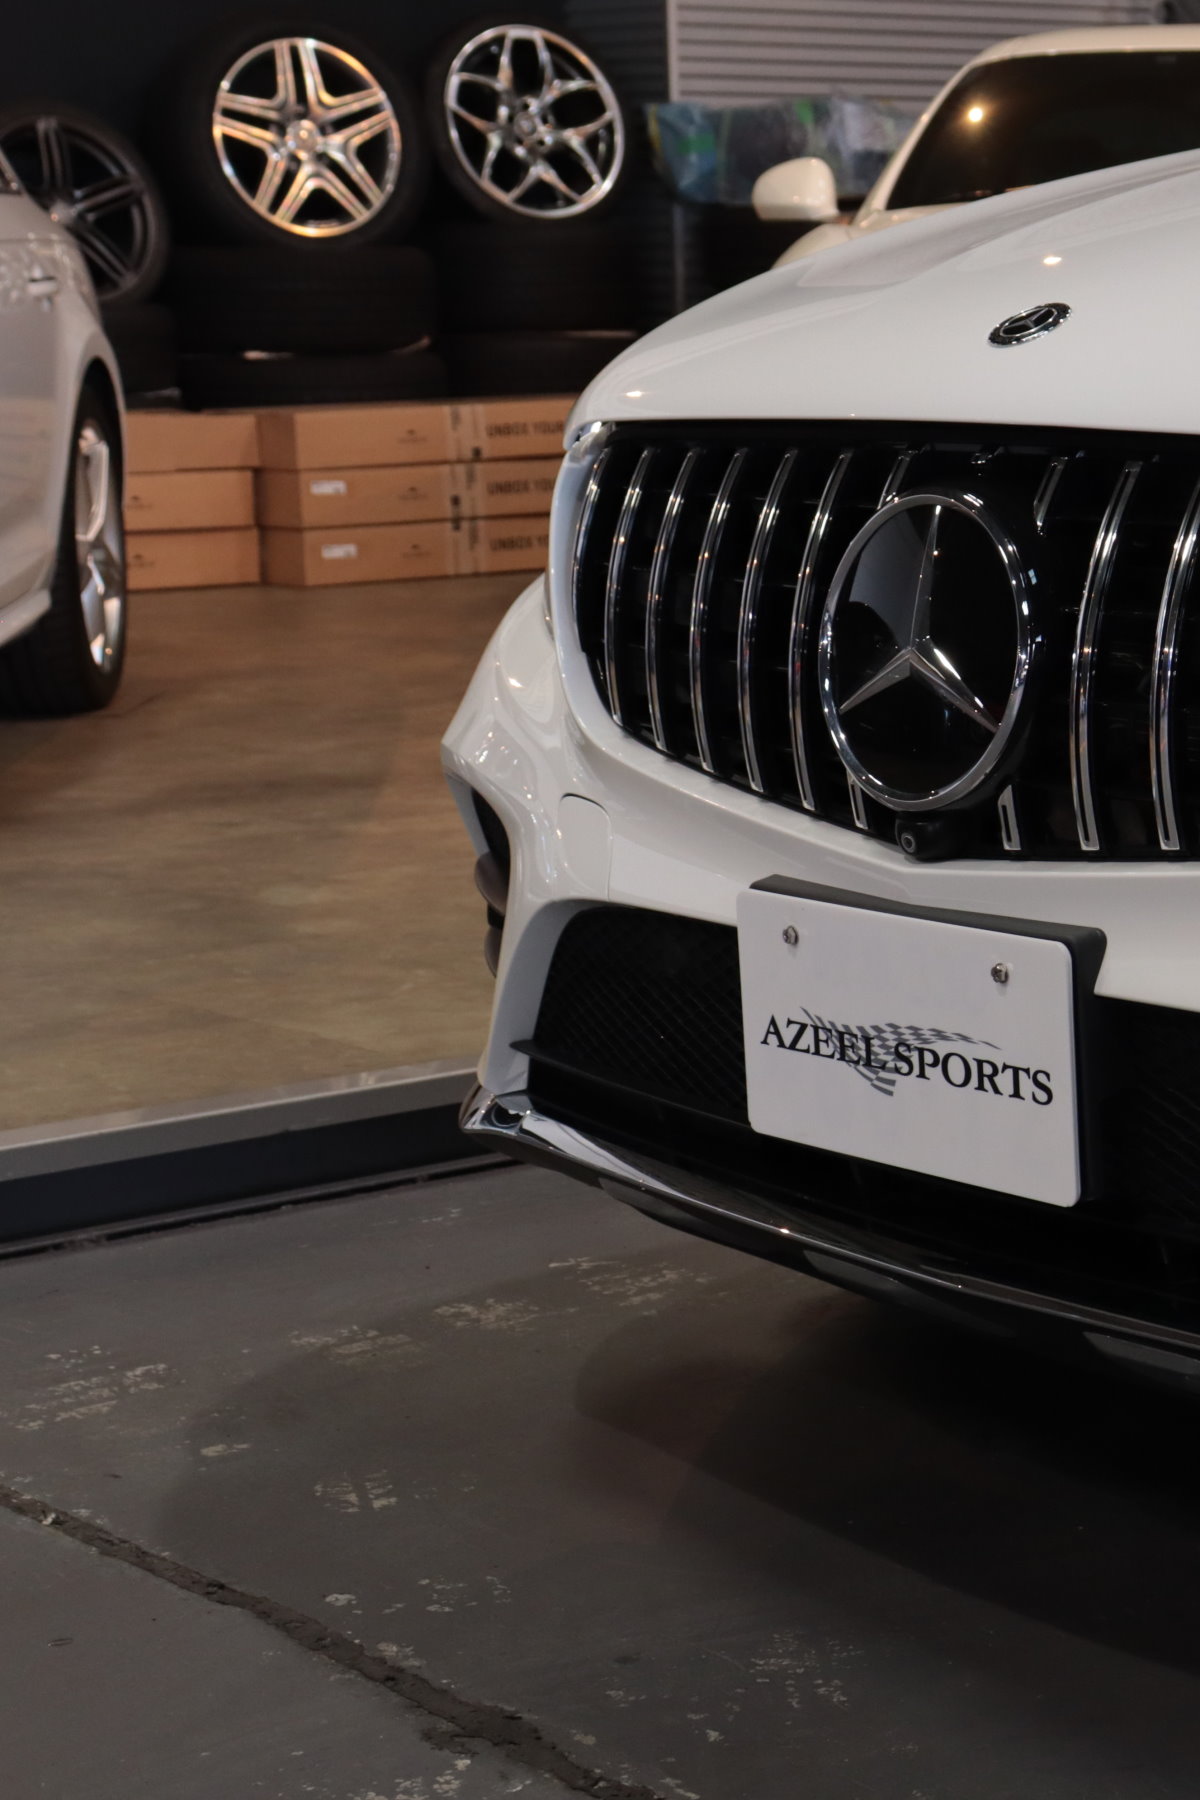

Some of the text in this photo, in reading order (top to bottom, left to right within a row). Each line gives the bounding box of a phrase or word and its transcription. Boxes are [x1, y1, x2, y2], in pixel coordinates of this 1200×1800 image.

[486, 422, 529, 438] UNBOX
[486, 480, 529, 495] UNBOX
[489, 537, 532, 552] UNBOX
[760, 1014, 1054, 1106] AZEEL SPORTS
